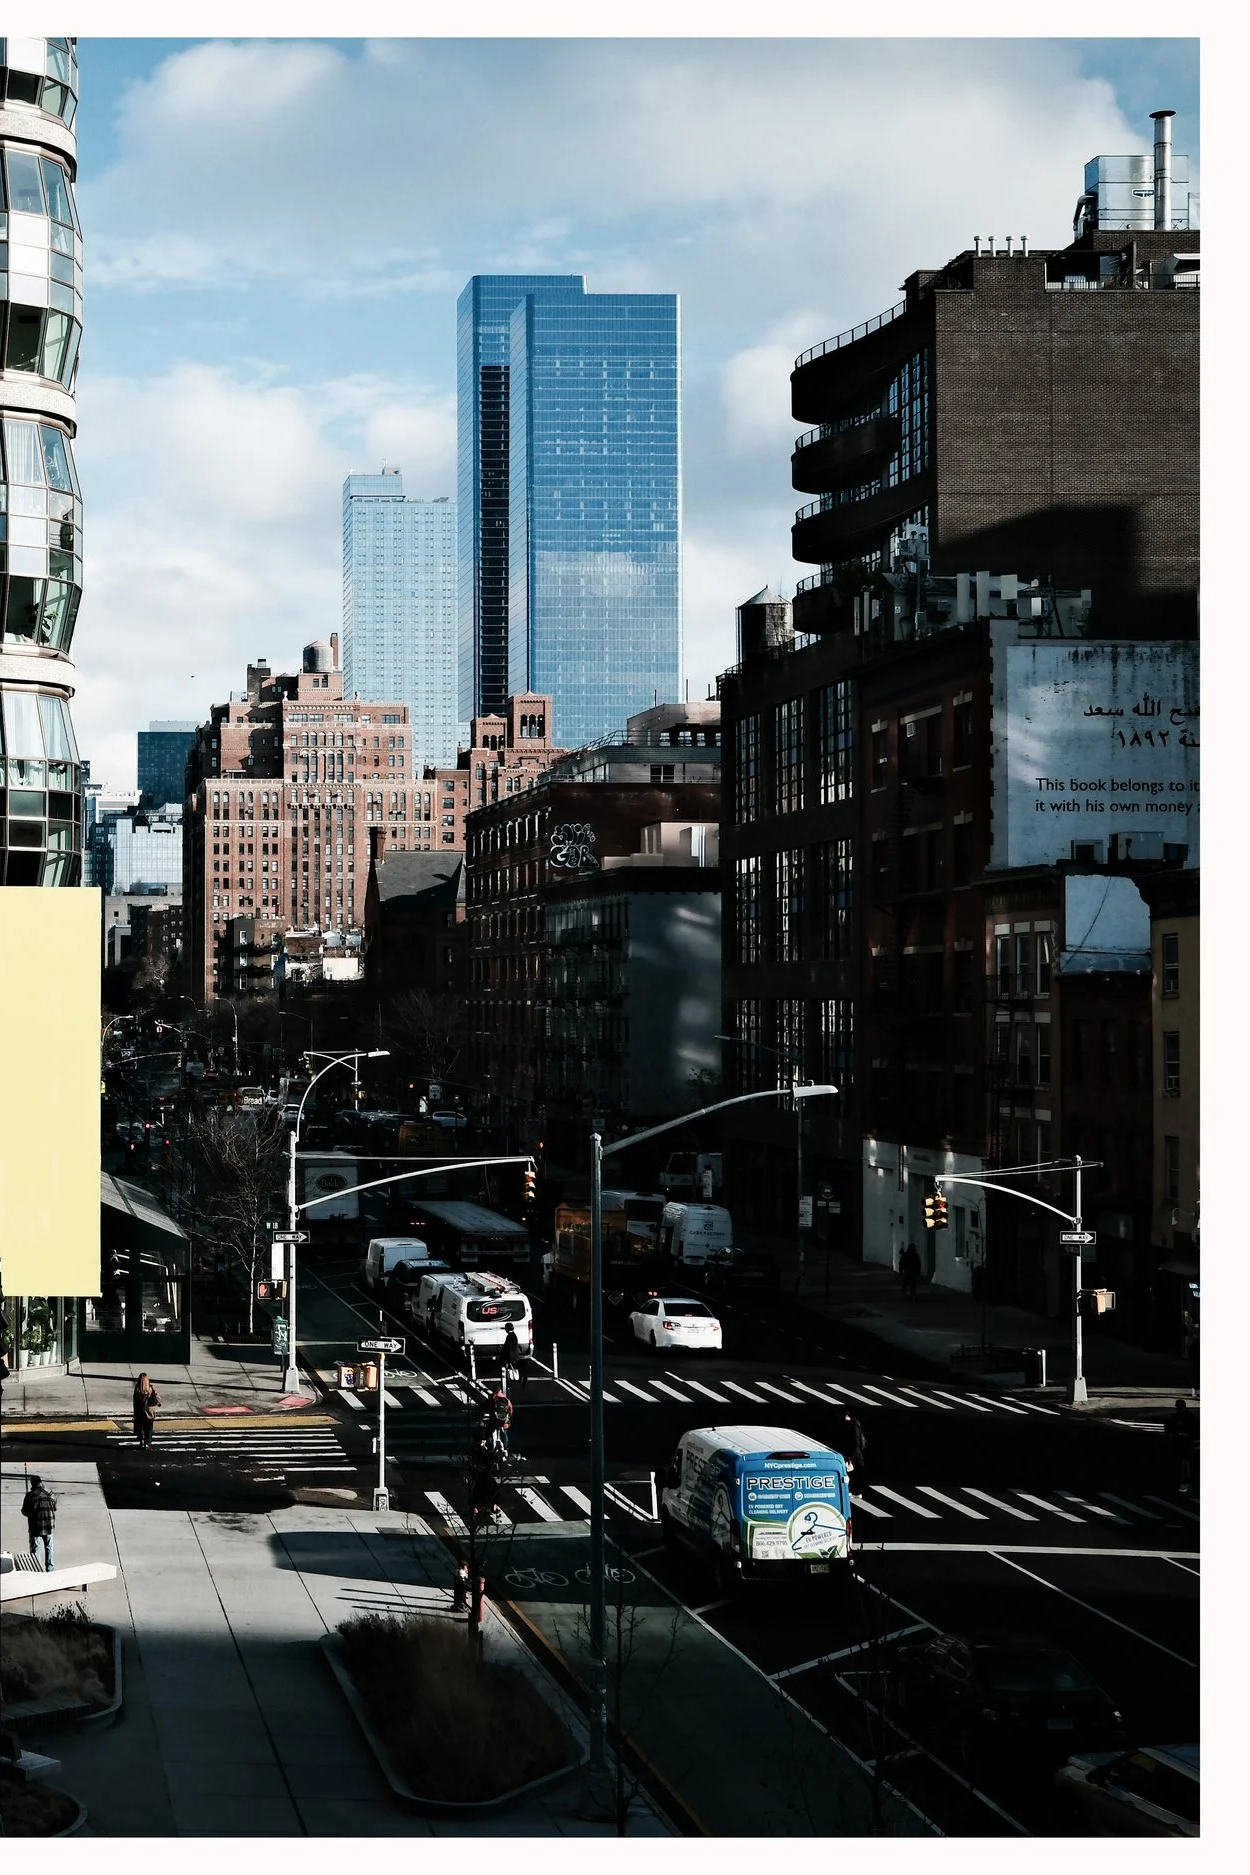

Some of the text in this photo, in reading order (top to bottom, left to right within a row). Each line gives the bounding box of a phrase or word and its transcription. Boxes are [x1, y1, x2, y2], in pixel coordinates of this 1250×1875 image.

[1083, 704, 1124, 717] سعد
[1132, 692, 1161, 716] الله
[1118, 730, 1170, 748] ١٨٩٢
[1035, 778, 1065, 792] This
[1070, 778, 1106, 792] book
[1111, 778, 1164, 796] belongs
[1169, 780, 1185, 792] to
[1035, 799, 1045, 812] it
[1050, 799, 1080, 812] with
[1086, 799, 1105, 812] his
[1110, 803, 1140, 812] own
[1145, 802, 1193, 817] money
[384, 1341, 398, 1349] WAY
[764, 1462, 817, 1470] NYCprestige.com
[746, 1475, 836, 1491] PRESTIGE
